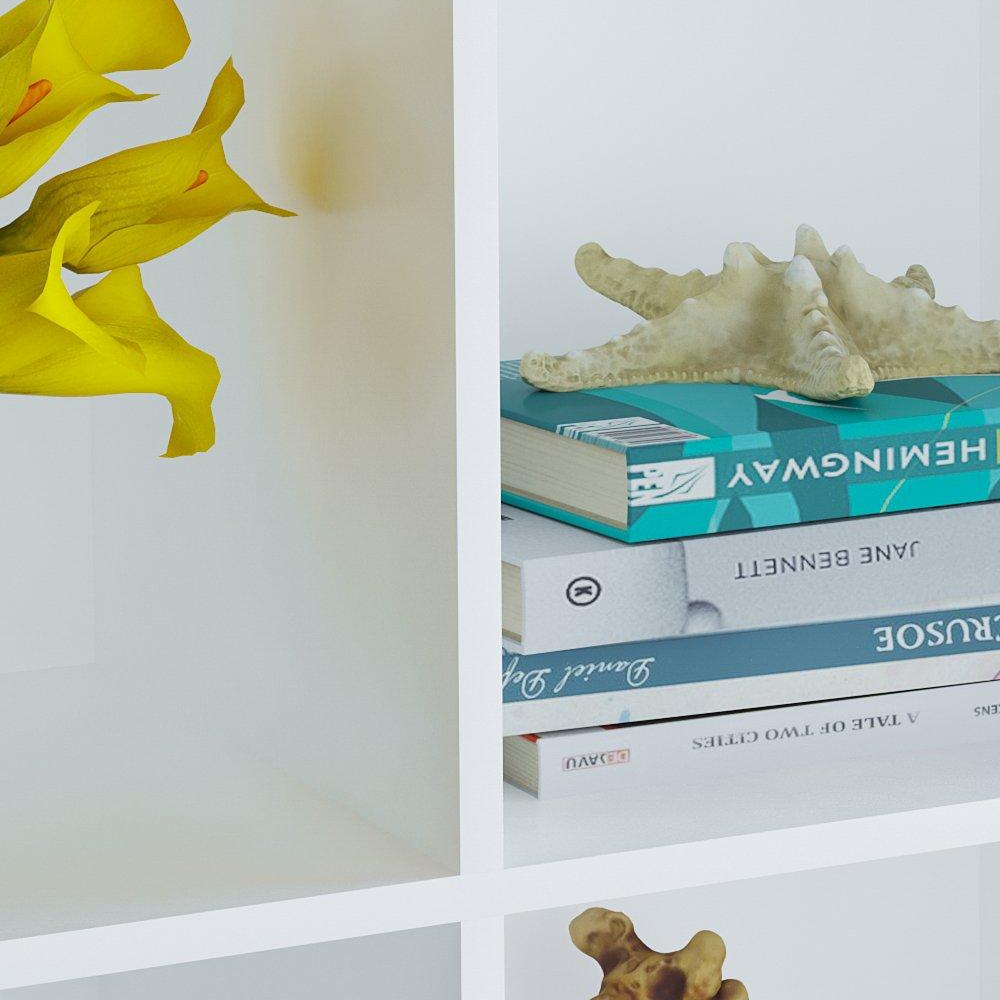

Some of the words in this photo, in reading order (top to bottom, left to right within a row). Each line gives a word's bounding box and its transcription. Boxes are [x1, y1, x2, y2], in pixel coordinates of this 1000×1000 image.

[727, 438, 987, 489] HEMINGWAY
[859, 540, 920, 565] JANE
[734, 549, 849, 580] BENNETT
[553, 657, 655, 694] Daniel
[820, 719, 846, 736] OF
[851, 713, 902, 731] TALE
[907, 711, 920, 724] A
[692, 730, 759, 750] CITIES
[764, 724, 812, 741] TWO
